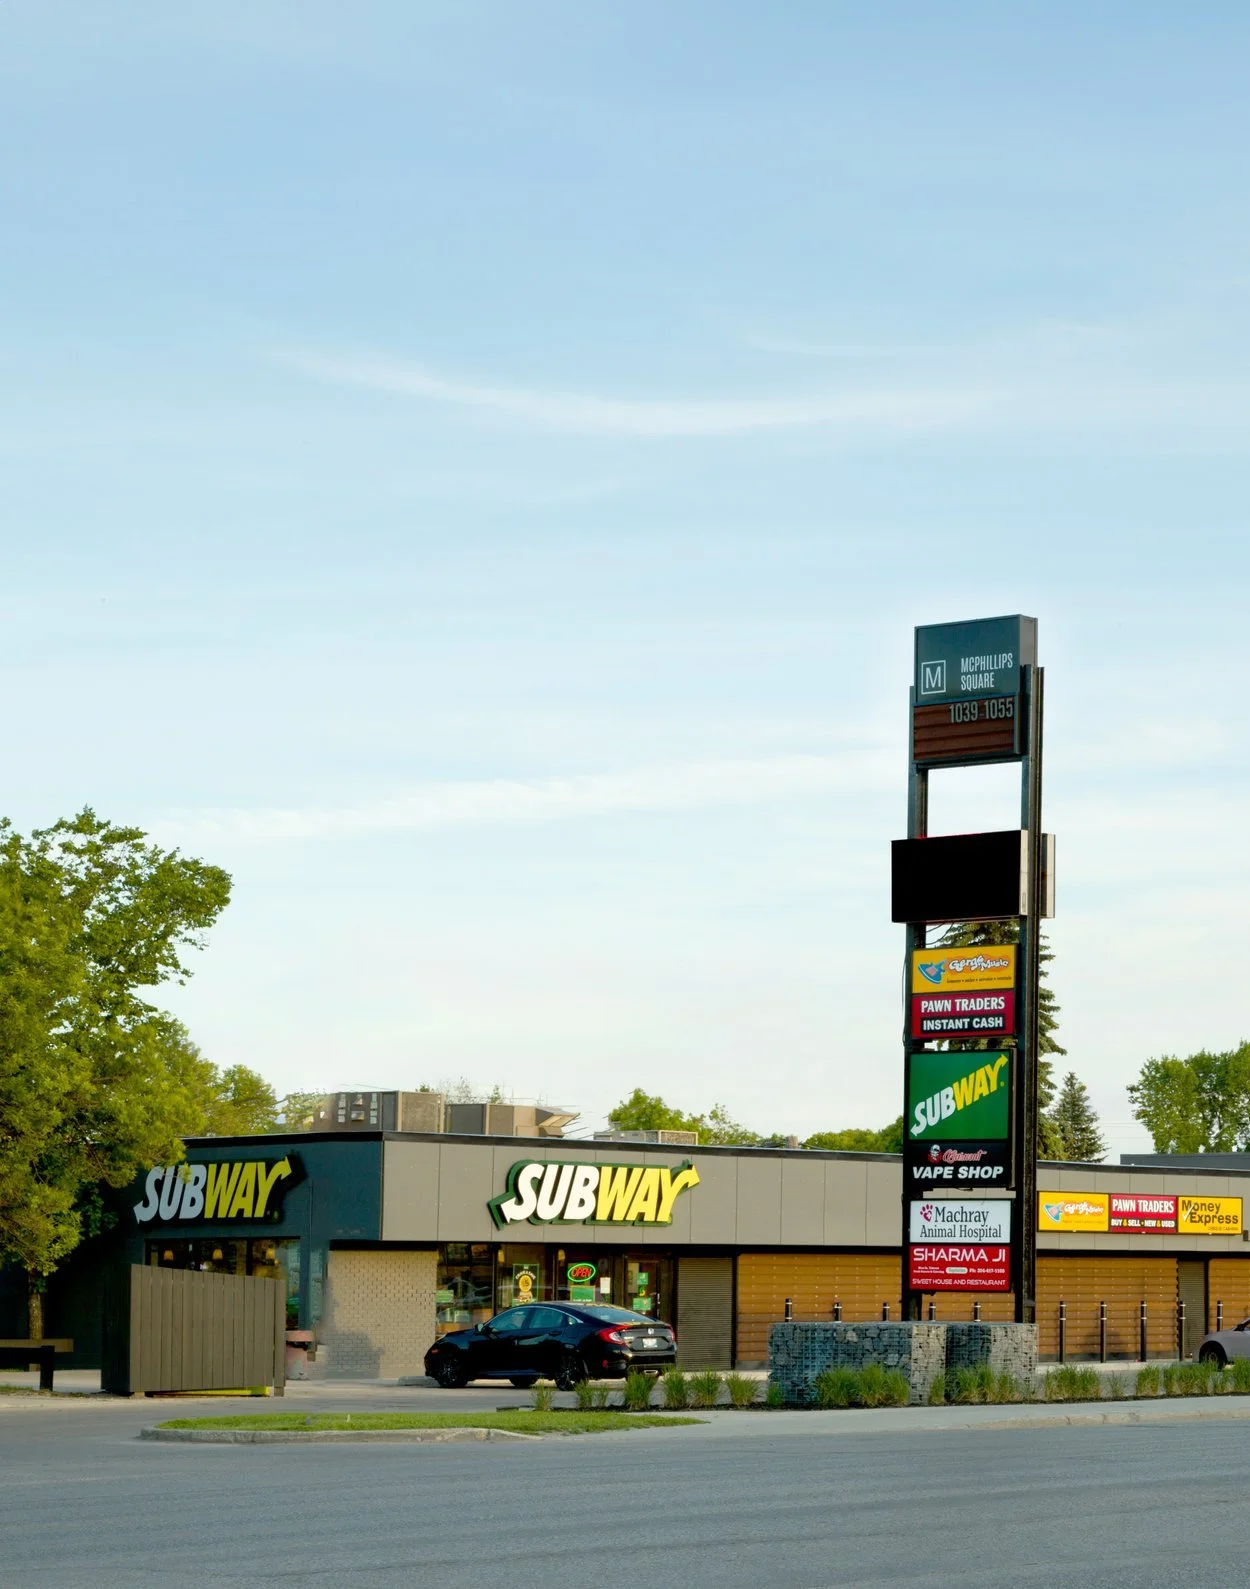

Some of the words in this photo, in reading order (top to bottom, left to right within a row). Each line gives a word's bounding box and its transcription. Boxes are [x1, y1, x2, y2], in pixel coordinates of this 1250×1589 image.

[960, 652, 1013, 673] MCPHILLIPS
[926, 667, 941, 688] M
[960, 672, 994, 691] SQUARE
[980, 959, 1008, 972] Music
[921, 1000, 952, 1013] PAWN
[955, 996, 1005, 1011] TRADERS
[923, 1018, 970, 1030] INSTANT
[972, 1017, 1003, 1028] CASH
[910, 1054, 1008, 1136] SUBWAY
[913, 1166, 954, 1178] VAPE
[958, 1166, 1004, 1178] SHOP
[134, 1155, 293, 1224] SUBWAY
[500, 1162, 700, 1225] SUBWAY
[1112, 1199, 1136, 1212] PAWN
[1138, 1200, 1174, 1213] TRADERS
[1182, 1200, 1220, 1214] Money
[934, 1206, 989, 1225] Machray
[1111, 1218, 1122, 1226] BUY
[1128, 1219, 1141, 1227] SELL
[1161, 1220, 1175, 1228] USED
[1190, 1212, 1238, 1226] Express
[920, 1224, 956, 1238] Animal
[960, 1224, 1002, 1241] Hospital
[913, 1248, 988, 1262] SHARMA
[992, 1248, 1006, 1262] JI
[571, 1266, 592, 1278] OPEN
